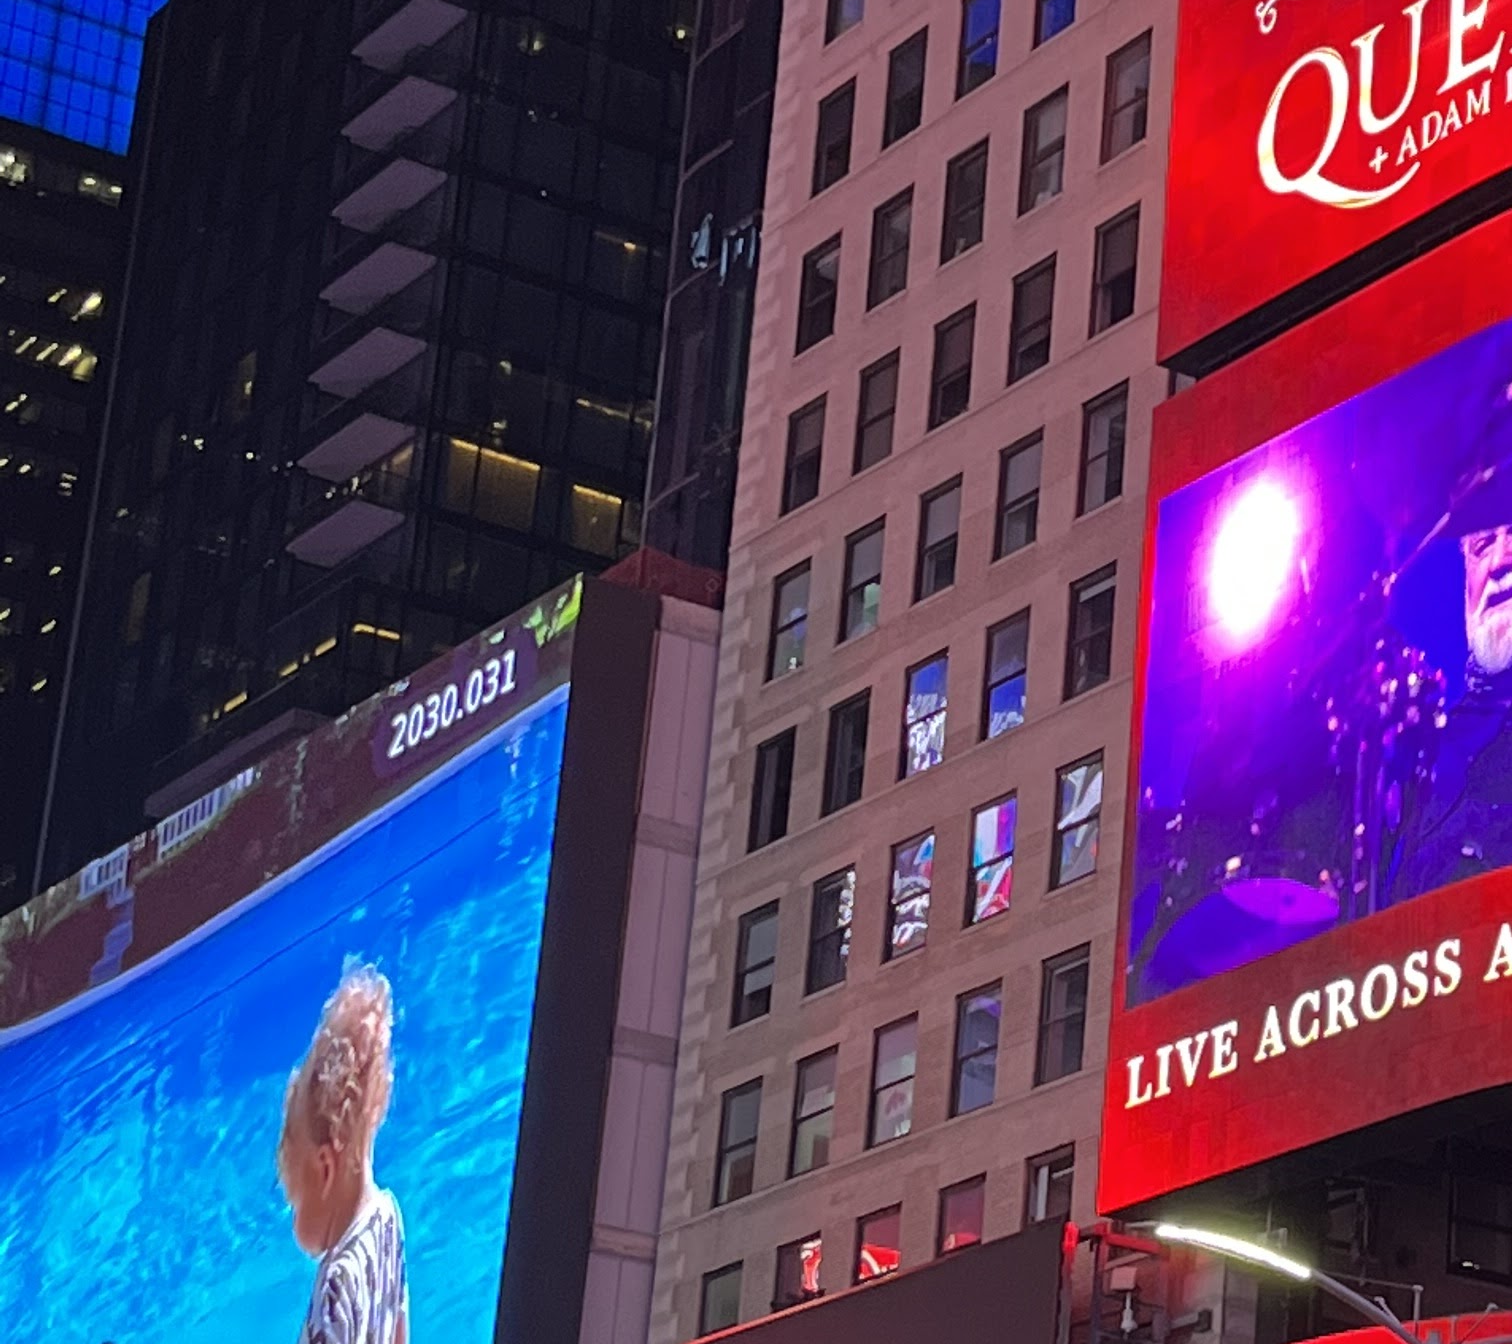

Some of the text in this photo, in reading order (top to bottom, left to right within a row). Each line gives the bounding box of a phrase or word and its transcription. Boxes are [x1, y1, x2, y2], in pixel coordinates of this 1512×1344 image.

[1395, 78, 1493, 167] ADAM
[387, 649, 517, 759] 2030.031
[1124, 1019, 1239, 1110] LIVE
[1253, 939, 1464, 1064] ACROSS
